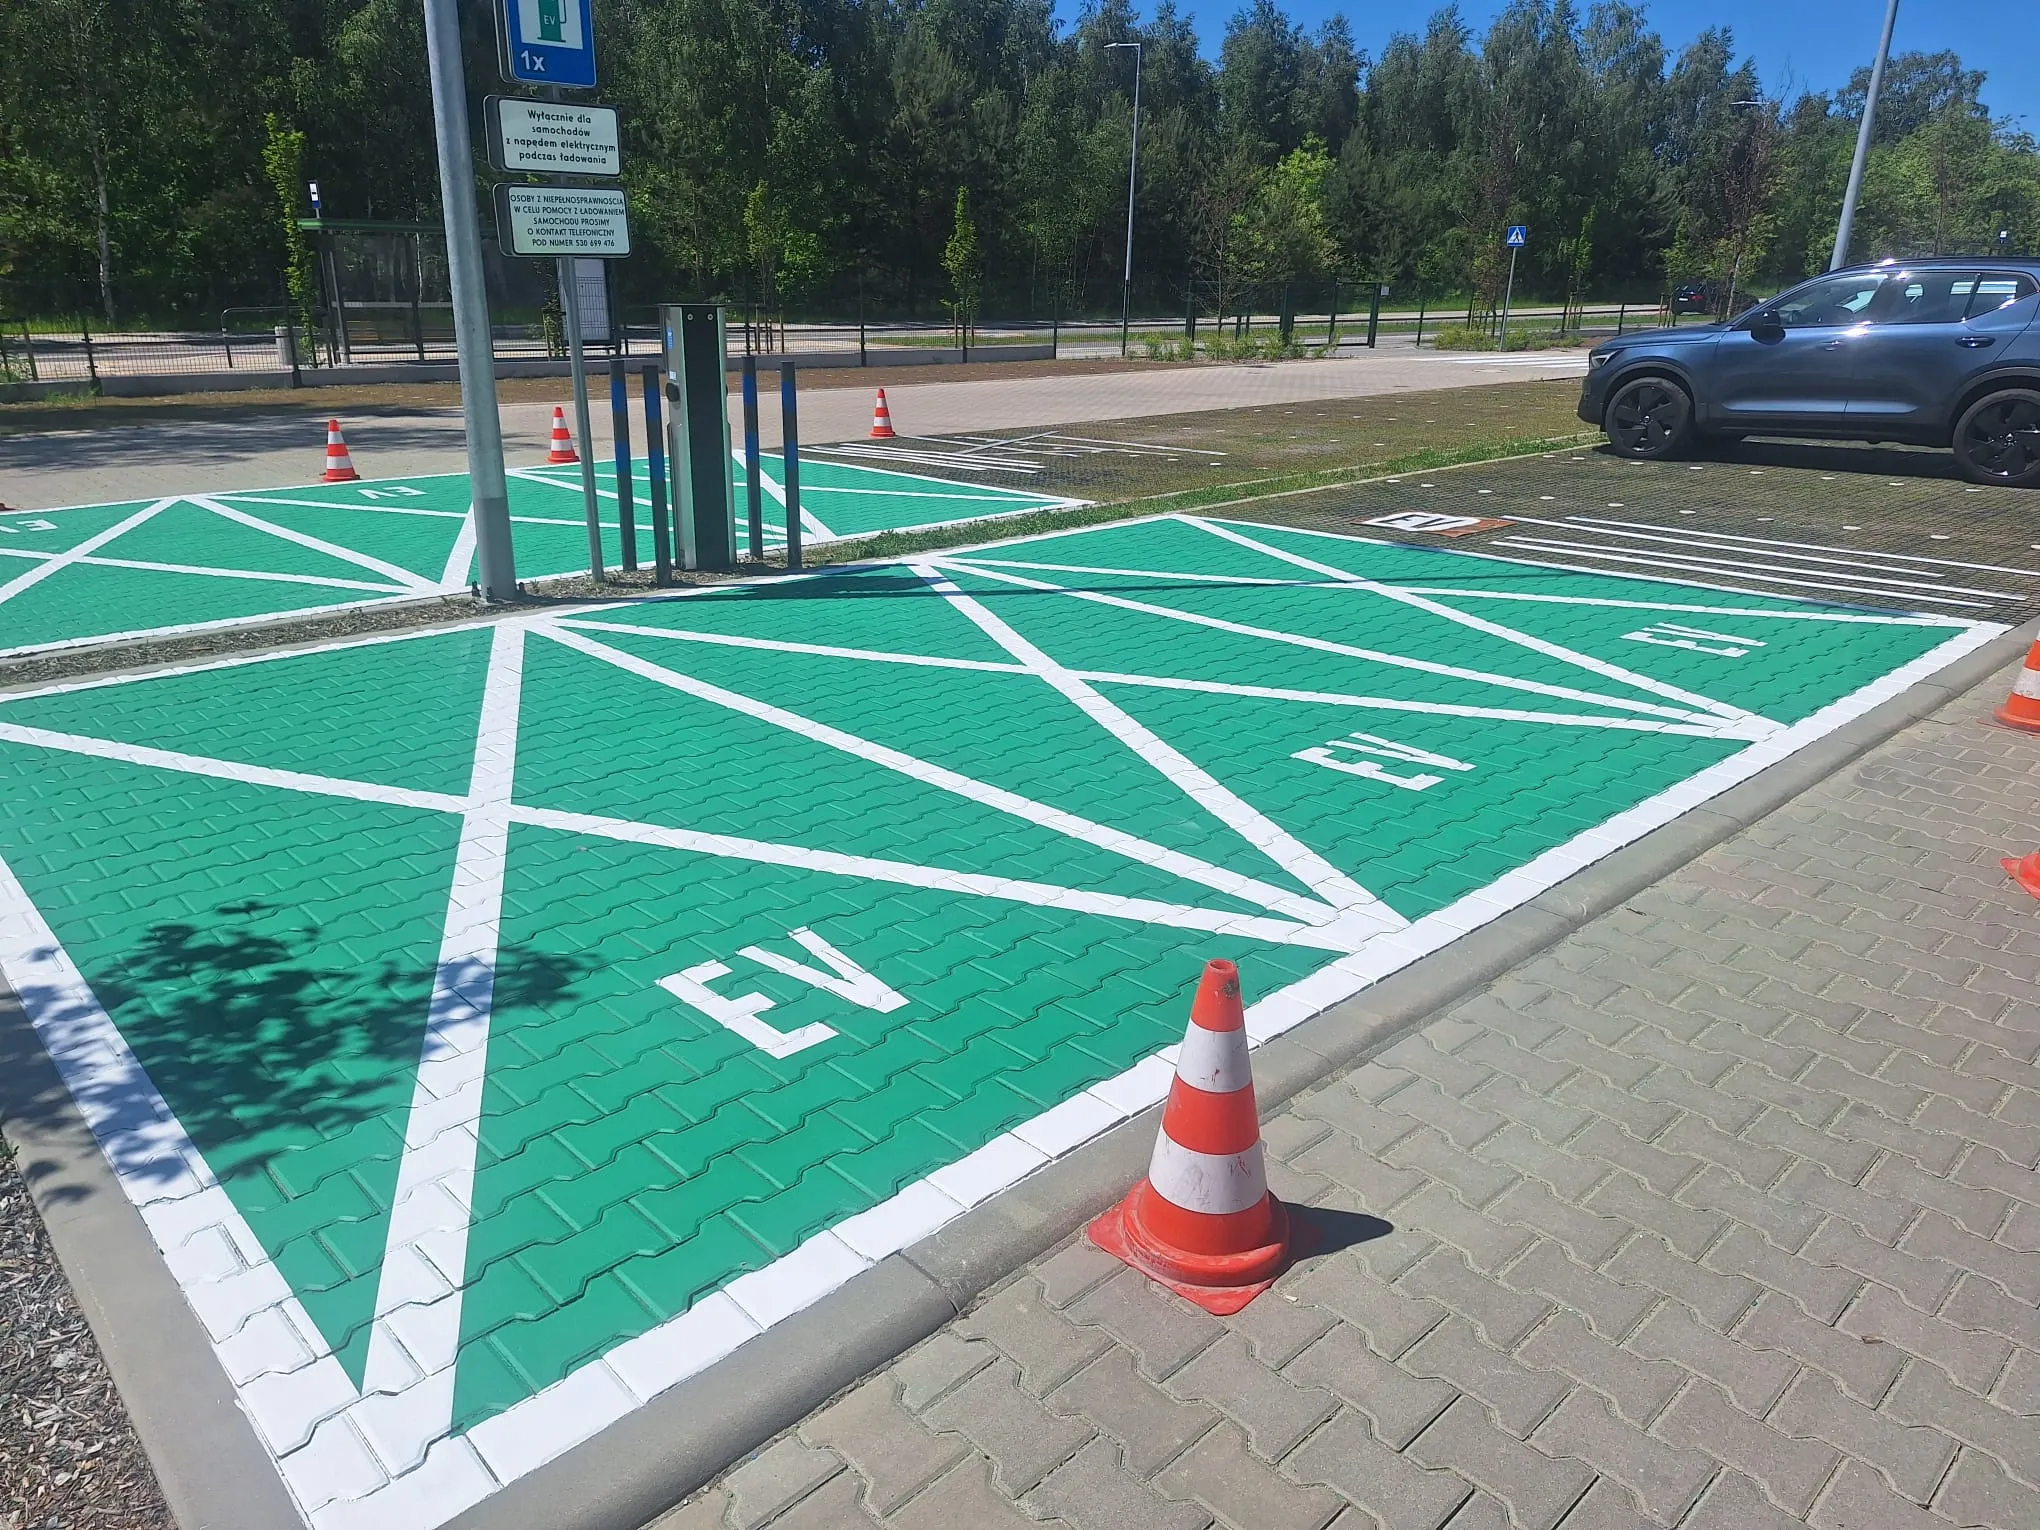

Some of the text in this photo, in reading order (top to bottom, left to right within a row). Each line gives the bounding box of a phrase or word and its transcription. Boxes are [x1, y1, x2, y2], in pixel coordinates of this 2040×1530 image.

[543, 14, 556, 26] EV
[521, 50, 546, 72] 1x
[528, 109, 592, 124] Wyłącznie dla
[532, 125, 591, 137] samochodów
[506, 137, 616, 153] z napędem elektrycznym
[519, 151, 607, 164] podczas ładowania
[510, 195, 535, 203] OSOBY
[537, 195, 541, 203] Z
[514, 205, 521, 213] W
[523, 206, 540, 214] CELU
[542, 206, 572, 214] POMOCY
[579, 207, 625, 216] ŁADOWANIEM
[533, 217, 610, 226] SAMOCHODU PROSIMY
[536, 228, 567, 236] KONTAKT
[568, 228, 615, 236] TELEFONICZNY
[549, 239, 573, 247] NUMER
[575, 239, 588, 247] 530
[590, 239, 601, 247] 699
[603, 239, 615, 247] 476
[357, 486, 427, 500] EV
[1620, 622, 1768, 658] EV
[1289, 732, 1477, 791] EV
[654, 926, 911, 1060] EV
